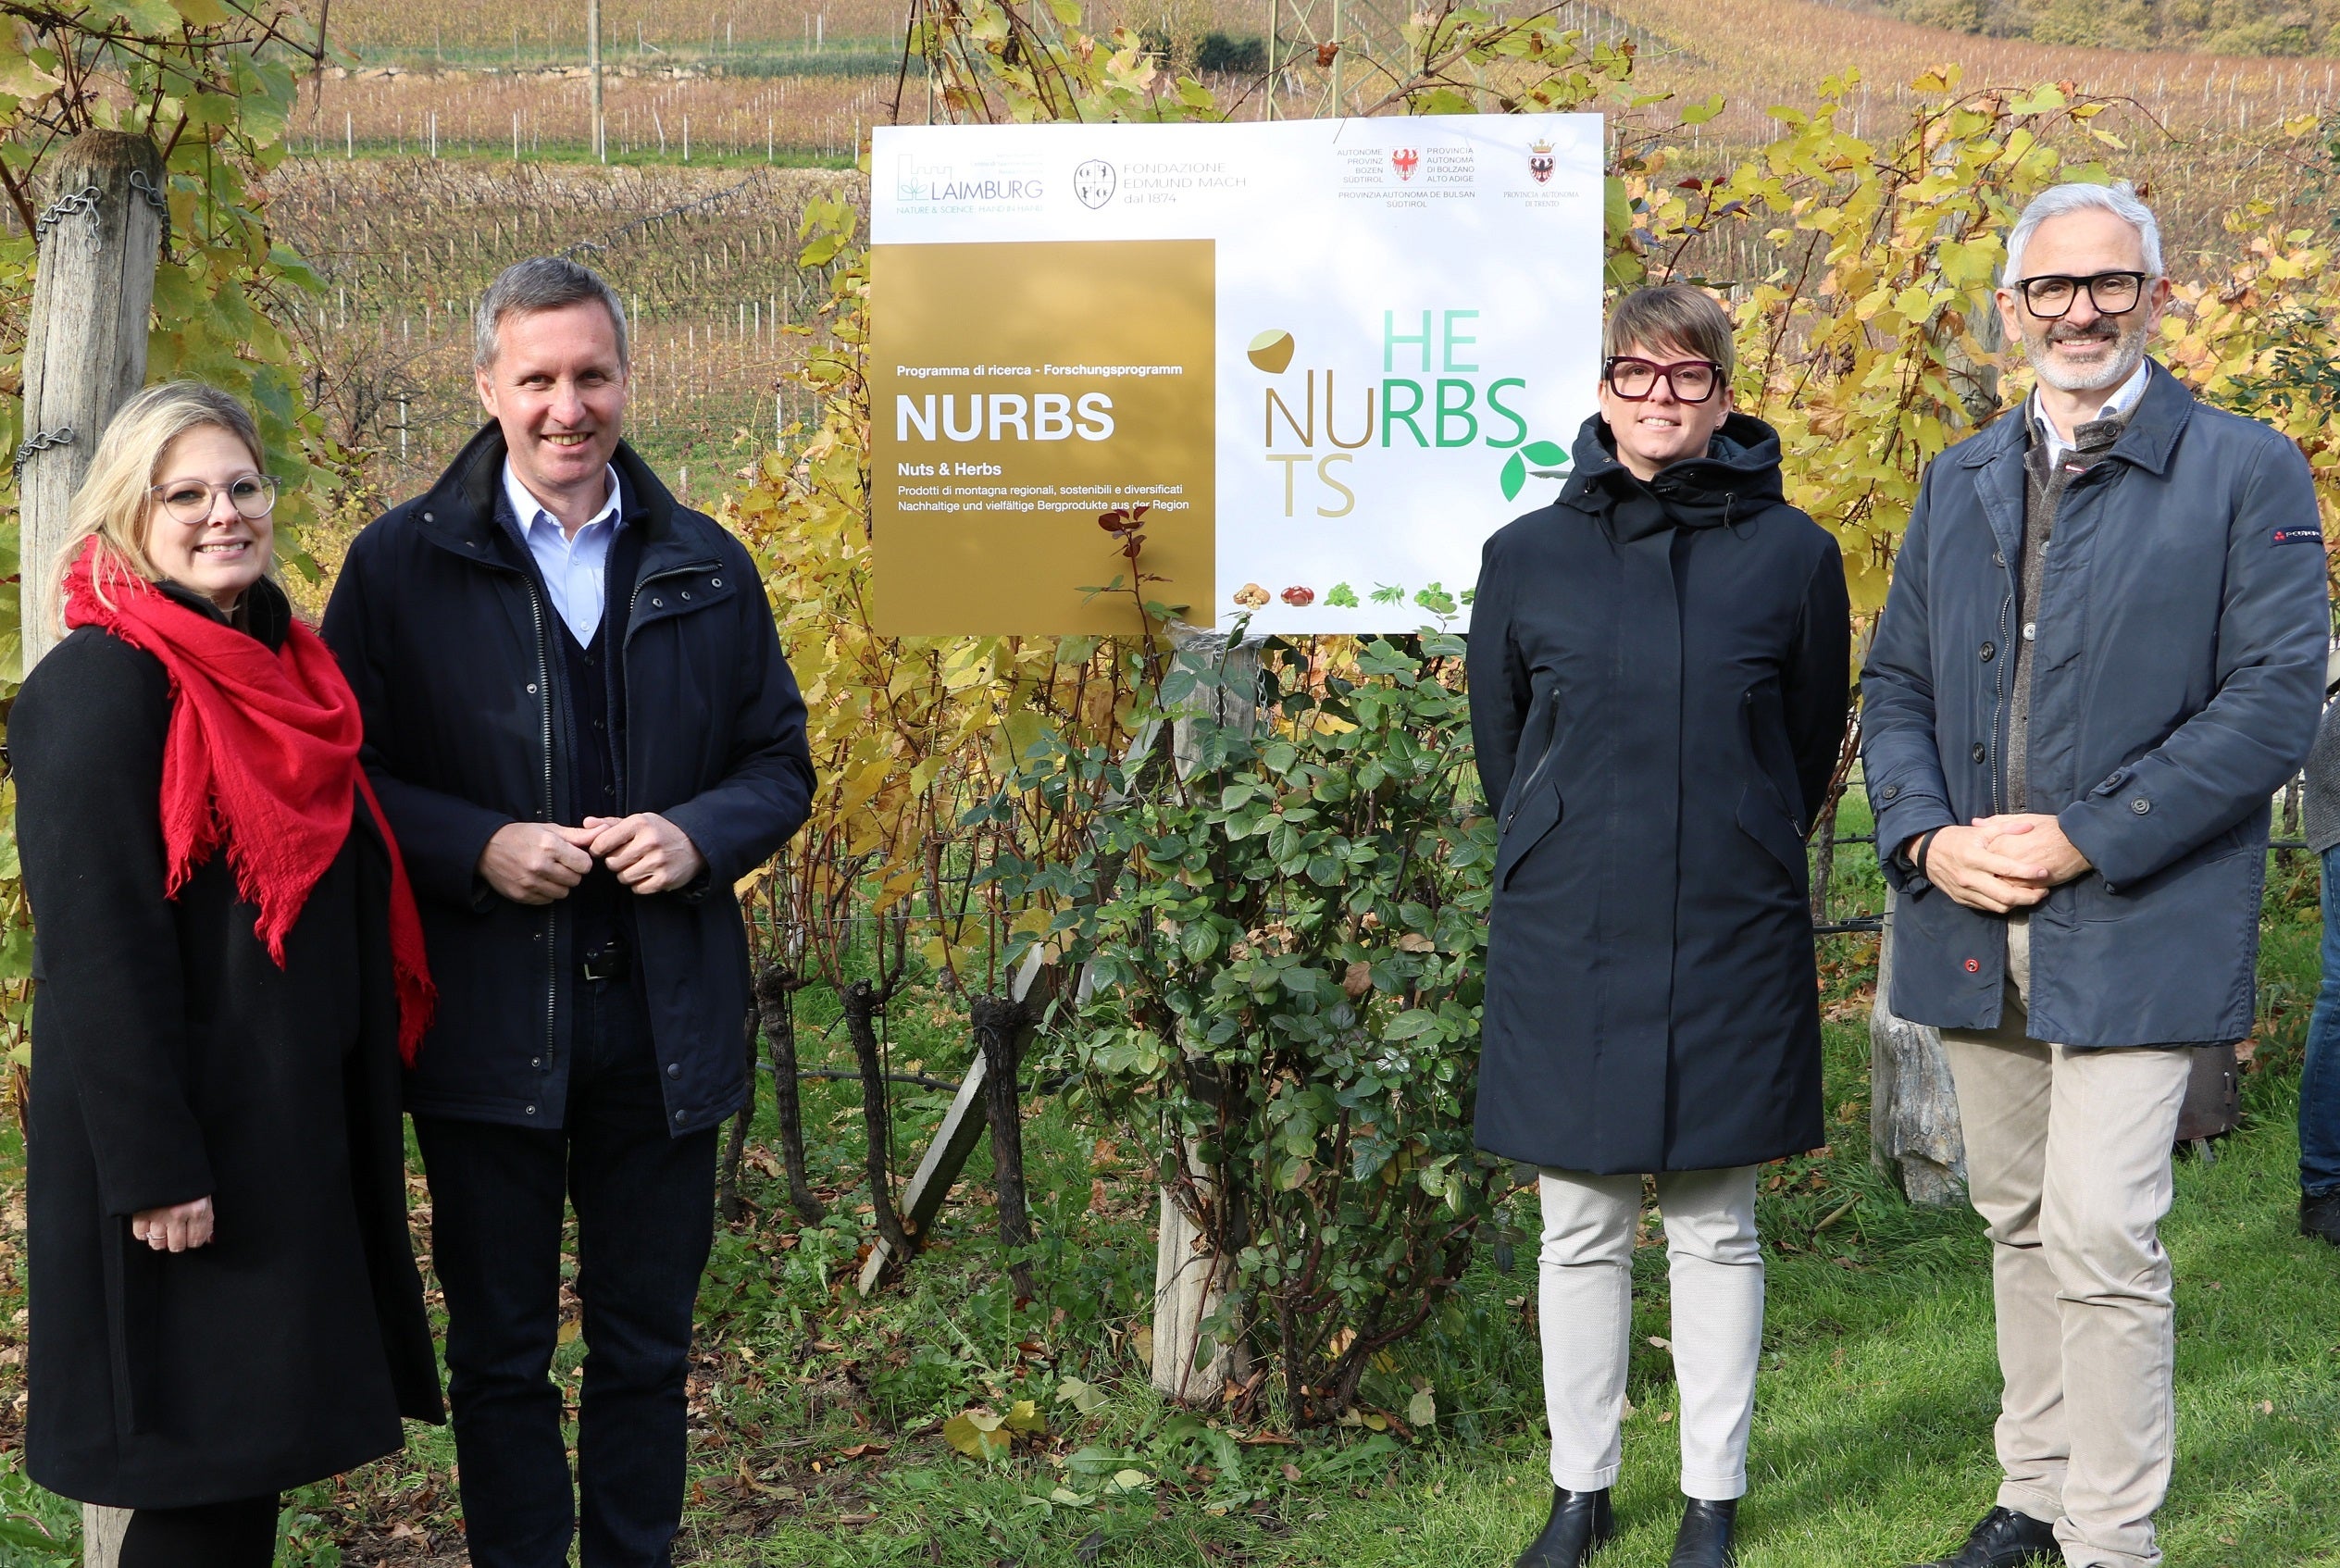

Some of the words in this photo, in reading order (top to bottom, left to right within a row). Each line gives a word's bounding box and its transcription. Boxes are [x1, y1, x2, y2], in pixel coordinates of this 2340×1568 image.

[1124, 162, 1226, 173] FONDAZIONE
[1124, 177, 1192, 188] EDMUND
[1199, 177, 1247, 188] MACH
[931, 180, 1043, 201] LAIMBURG
[1124, 194, 1143, 204] dal
[1147, 193, 1176, 204] 1874
[1387, 200, 1427, 208] SÜDTIROL
[931, 205, 938, 214] &
[897, 366, 970, 378] Programma
[974, 365, 985, 375] di
[988, 365, 1031, 375] ricerca
[1044, 365, 1182, 377] Forschungsprogramm
[1265, 369, 1527, 449] NURBS
[896, 392, 1115, 442] NURBS
[898, 463, 934, 477] Nuts
[939, 463, 951, 476] &
[954, 463, 1002, 476] Herbs
[898, 485, 940, 496] Prodotti
[942, 485, 952, 496] di
[954, 487, 1007, 498] montagna
[1010, 485, 1057, 497] regionali,
[1060, 485, 1112, 495] sostenibili
[1124, 484, 1183, 494] diversificati
[898, 501, 959, 513] Nachhaltige
[963, 501, 983, 511] und
[986, 500, 1034, 513] vielfältige
[1038, 500, 1108, 513] Bergprodukte
[1153, 500, 1189, 512] Region
